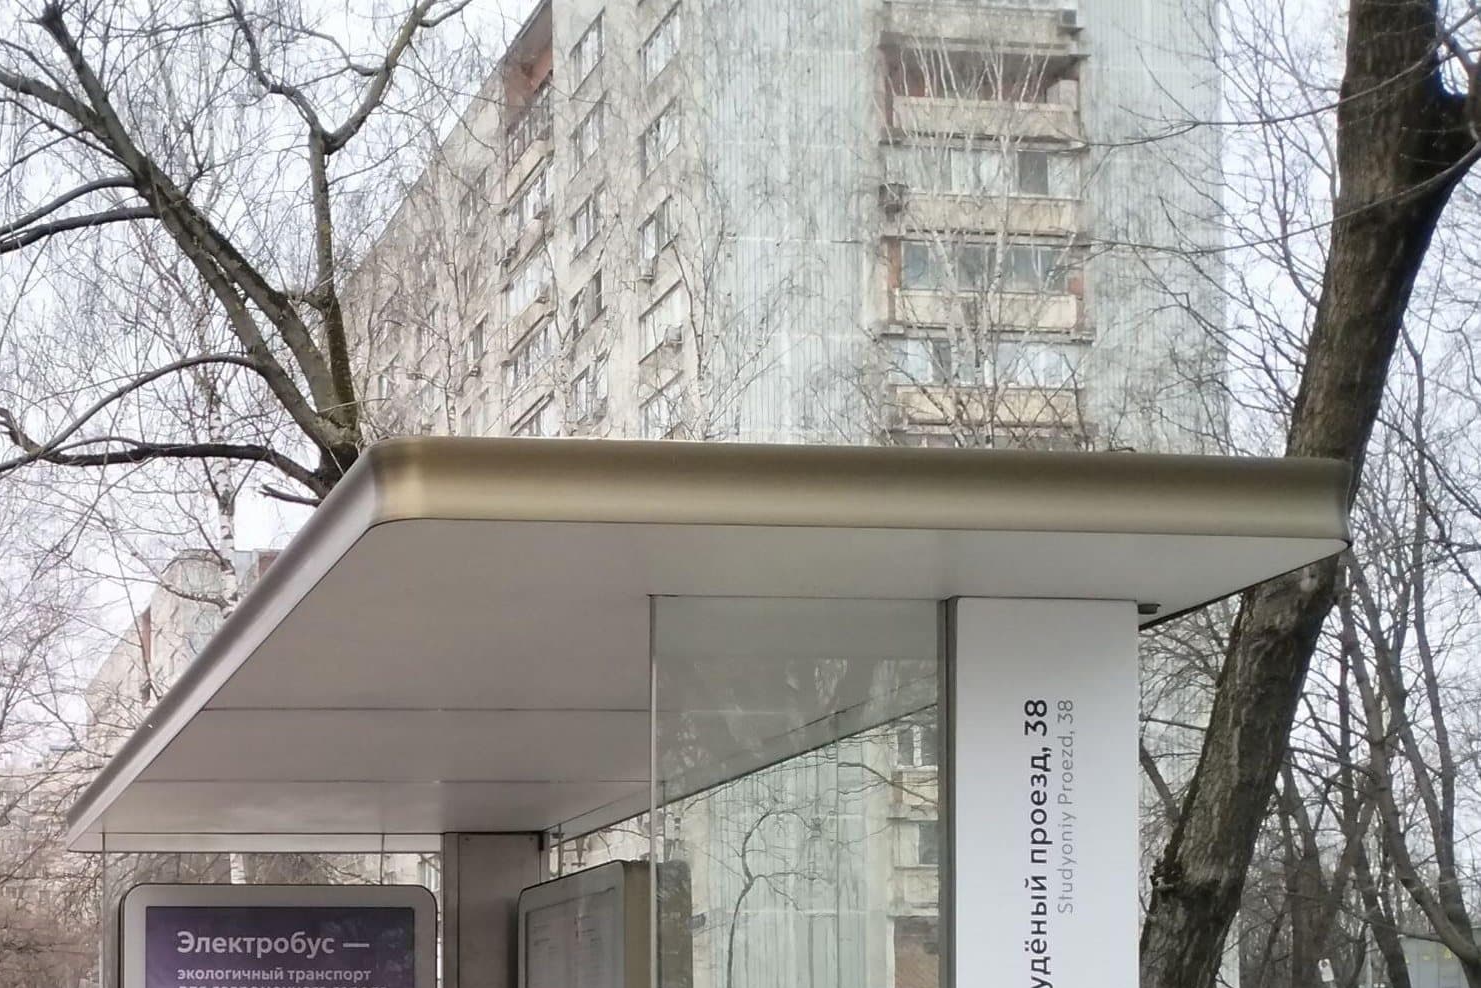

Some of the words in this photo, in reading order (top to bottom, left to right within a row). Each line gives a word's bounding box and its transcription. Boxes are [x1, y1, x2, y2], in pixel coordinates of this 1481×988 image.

[1024, 699, 1048, 737] 38
[1057, 699, 1074, 724] 38
[1057, 730, 1075, 805] Proezd,
[1030, 745, 1052, 864] проезд,
[1057, 811, 1077, 914] Studyoniy
[176, 930, 335, 959] Электробус
[176, 966, 284, 981] экологичный
[287, 968, 371, 983] транспорт
